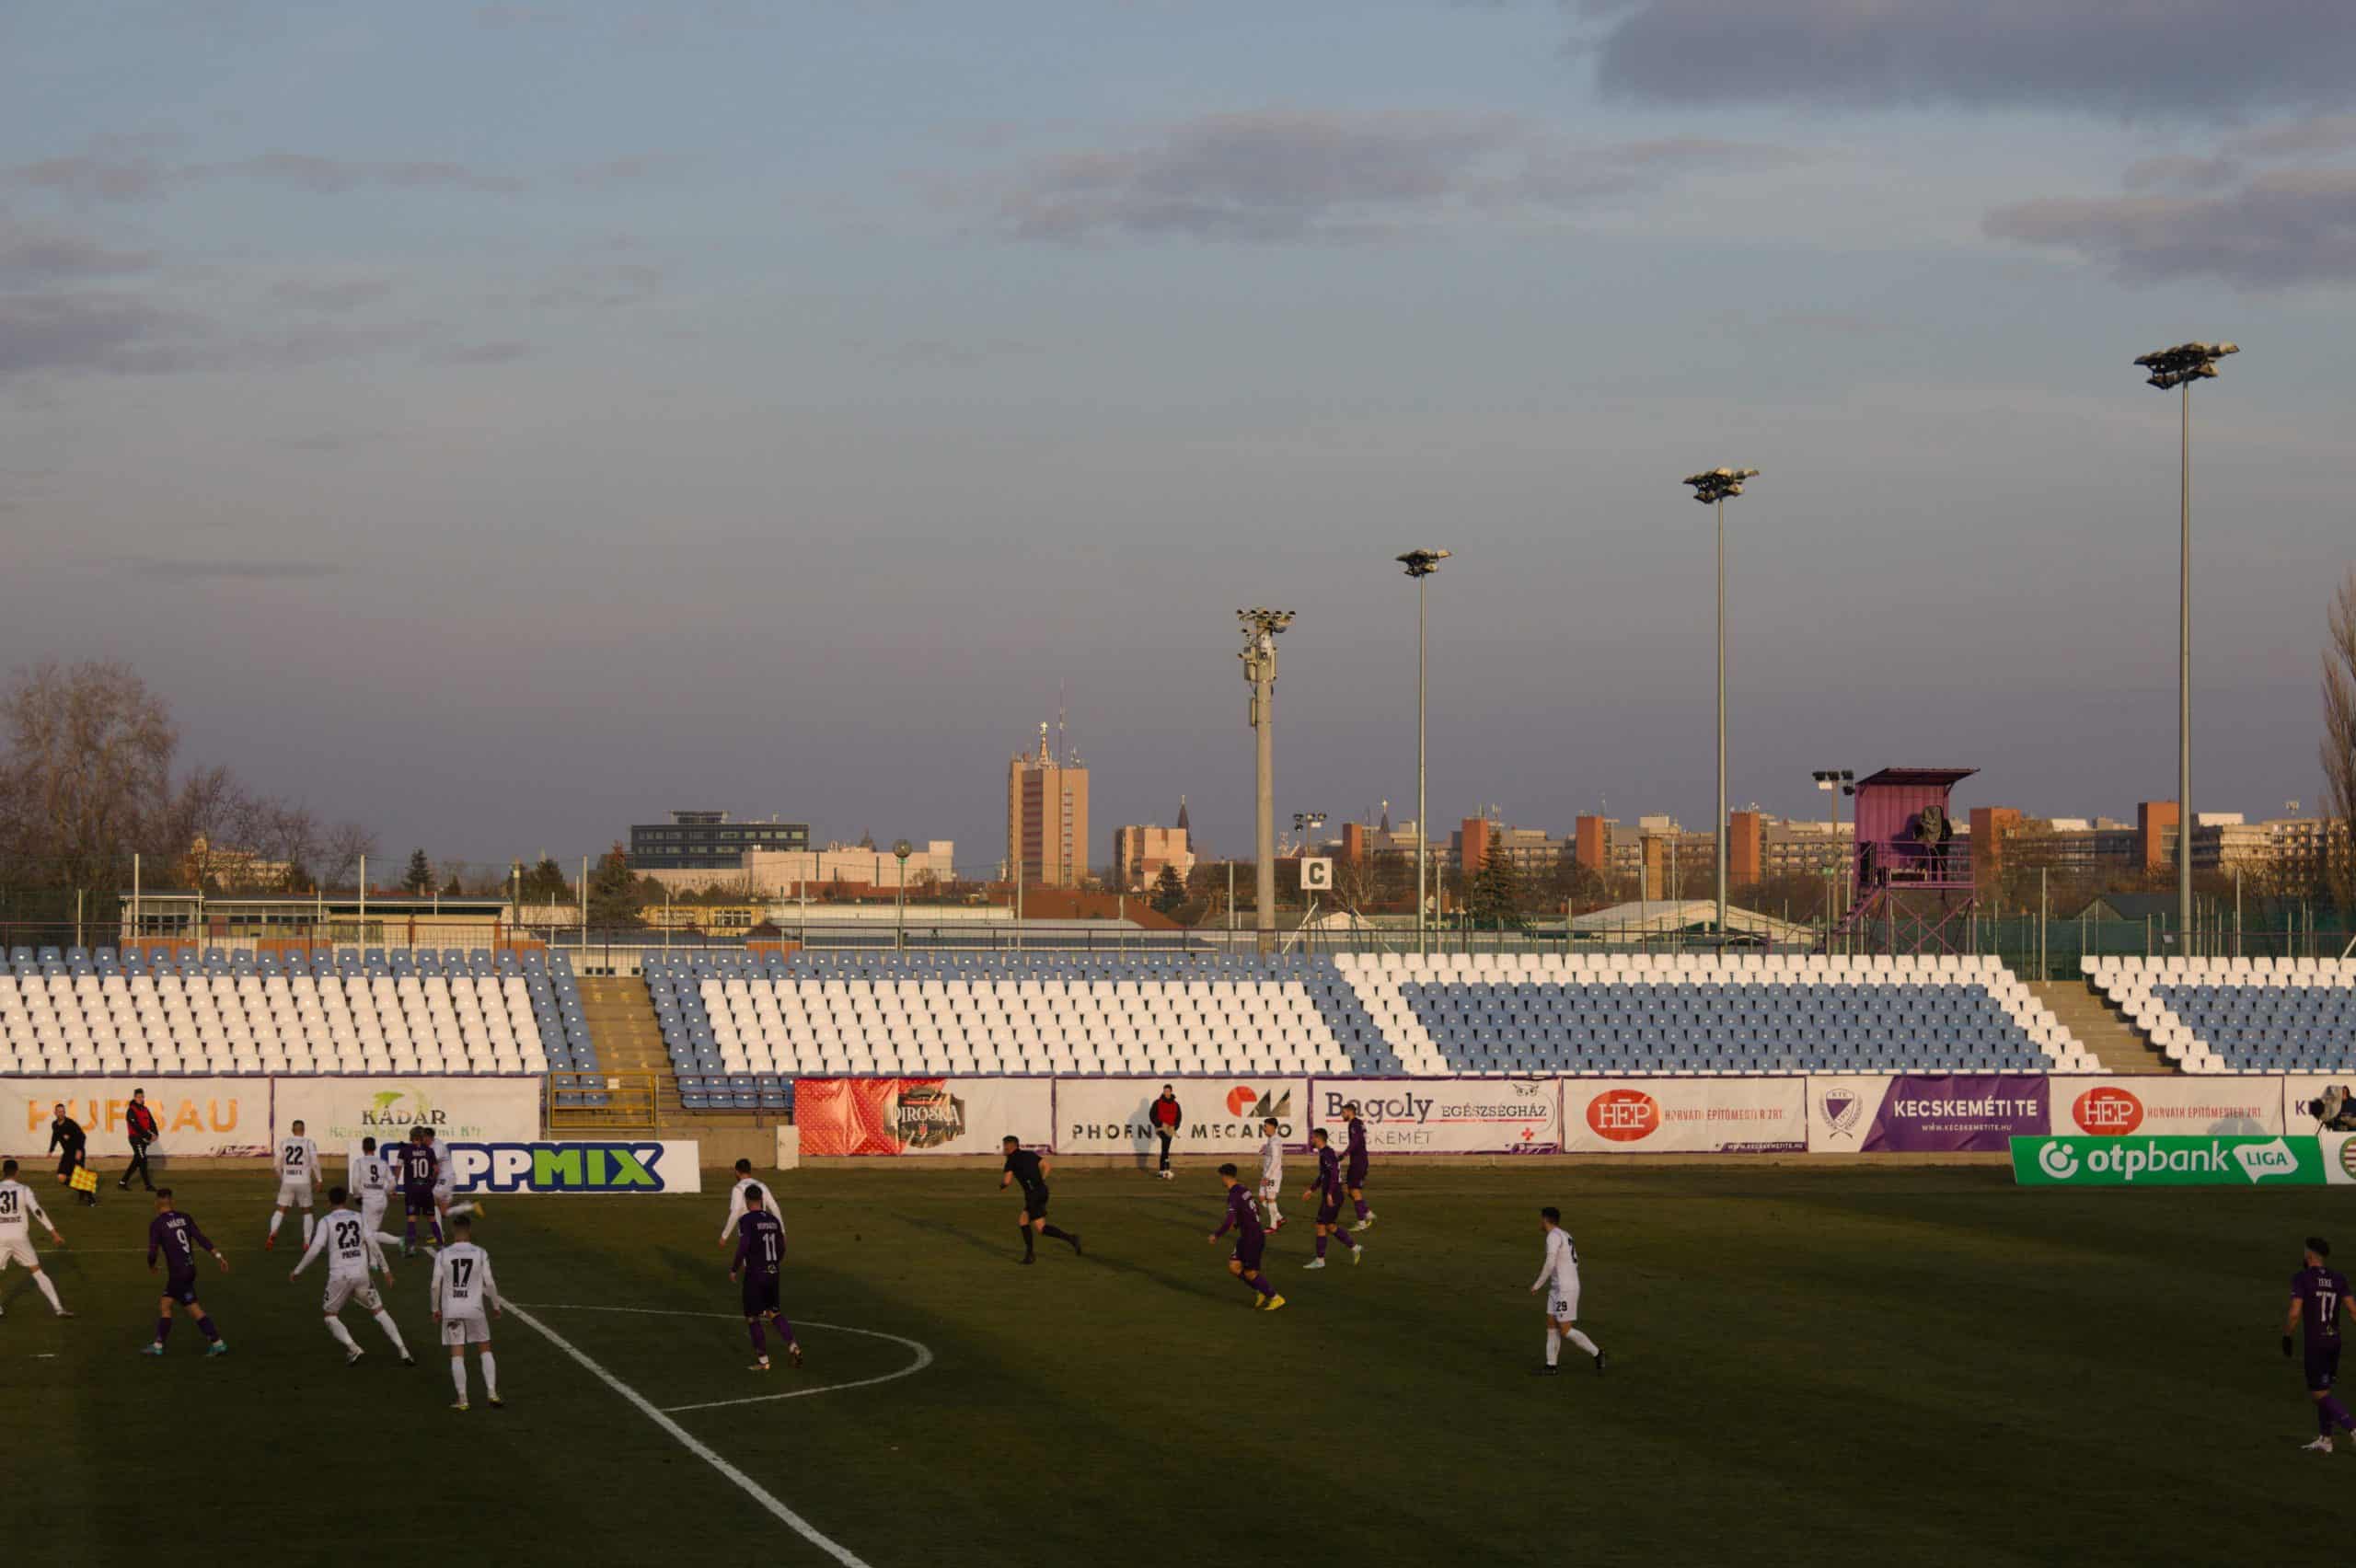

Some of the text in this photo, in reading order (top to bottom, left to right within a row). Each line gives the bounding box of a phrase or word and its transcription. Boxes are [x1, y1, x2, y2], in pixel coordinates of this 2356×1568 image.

[1309, 861, 1325, 884] C
[1324, 1091, 1547, 1124] Bagoly EGÉSZSÉGHÁZ
[1893, 1095, 2038, 1118] KECSKEMÉTI TE
[1072, 1124, 1181, 1140] PHOEN
[284, 1146, 304, 1165] 22
[387, 1149, 656, 1186] PPMIX
[2087, 1140, 2288, 1181] otpbank LIGA
[369, 1164, 380, 1183] 9
[410, 1158, 429, 1179] 10
[0, 1190, 18, 1215] 31
[176, 1228, 191, 1253] 9
[336, 1220, 361, 1250] 23
[762, 1233, 778, 1262] 11
[450, 1258, 474, 1287] 17
[1555, 1300, 1568, 1312] 29
[2316, 1291, 2338, 1322] 77
